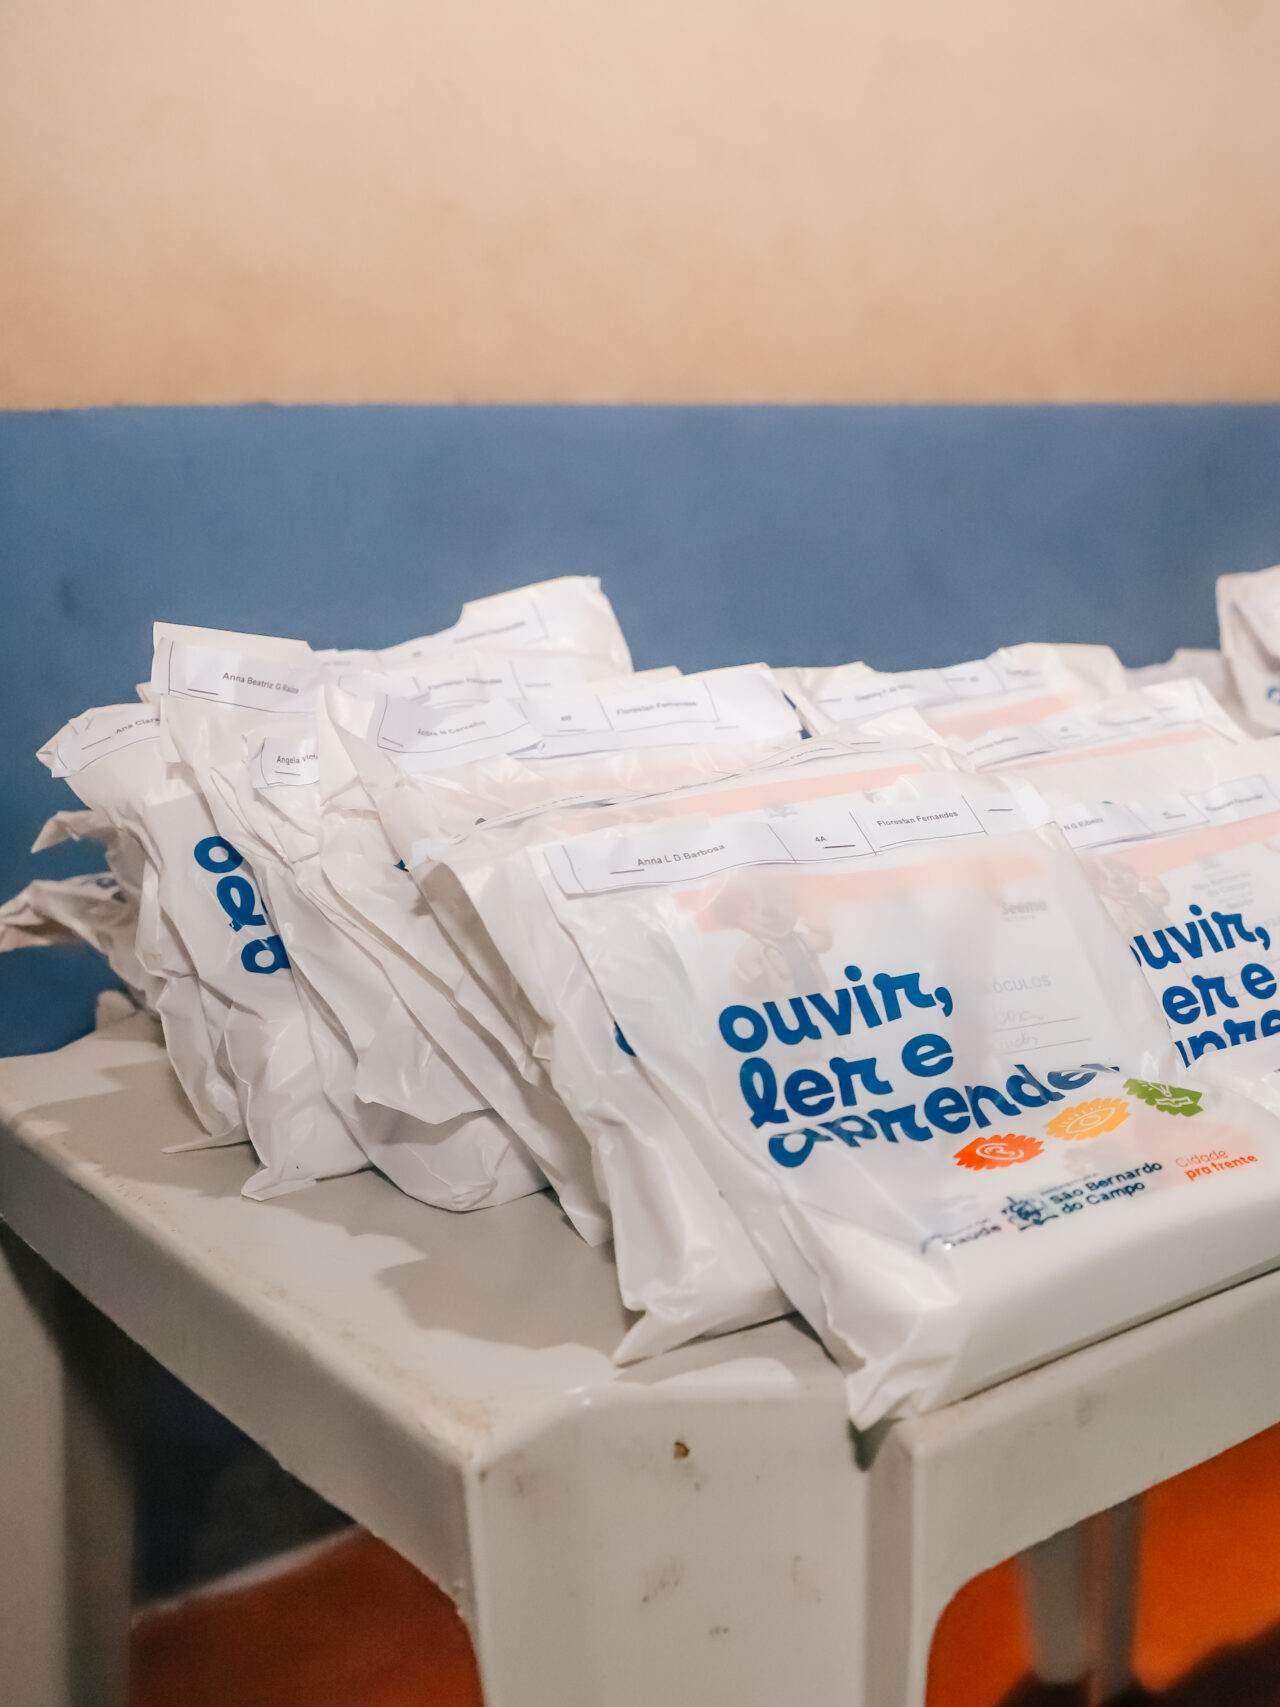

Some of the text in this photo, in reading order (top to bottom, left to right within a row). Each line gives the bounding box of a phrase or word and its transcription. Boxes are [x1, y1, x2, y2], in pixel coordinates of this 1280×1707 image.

[222, 672, 245, 684] Anna
[247, 676, 274, 689] Beatriz
[116, 724, 133, 735] Ana
[277, 755, 300, 766] Angela
[637, 857, 662, 867] Anna
[664, 855, 672, 863] L
[673, 853, 682, 862] D
[683, 844, 726, 860] Barbosa
[877, 817, 916, 828] Florestan
[916, 811, 959, 823] Fernandes
[1129, 904, 1270, 969] uvir,
[718, 965, 953, 1053] ouvir,
[1162, 963, 1277, 1025] er e
[739, 1033, 954, 1128] ler e
[1175, 1149, 1228, 1168] Cidade
[1185, 1153, 1259, 1182] pra frente
[1049, 1187, 1084, 1206] São
[1085, 1161, 1163, 1192] Bernardo
[1062, 1201, 1083, 1215] do
[1086, 1180, 1146, 1206] Campo
